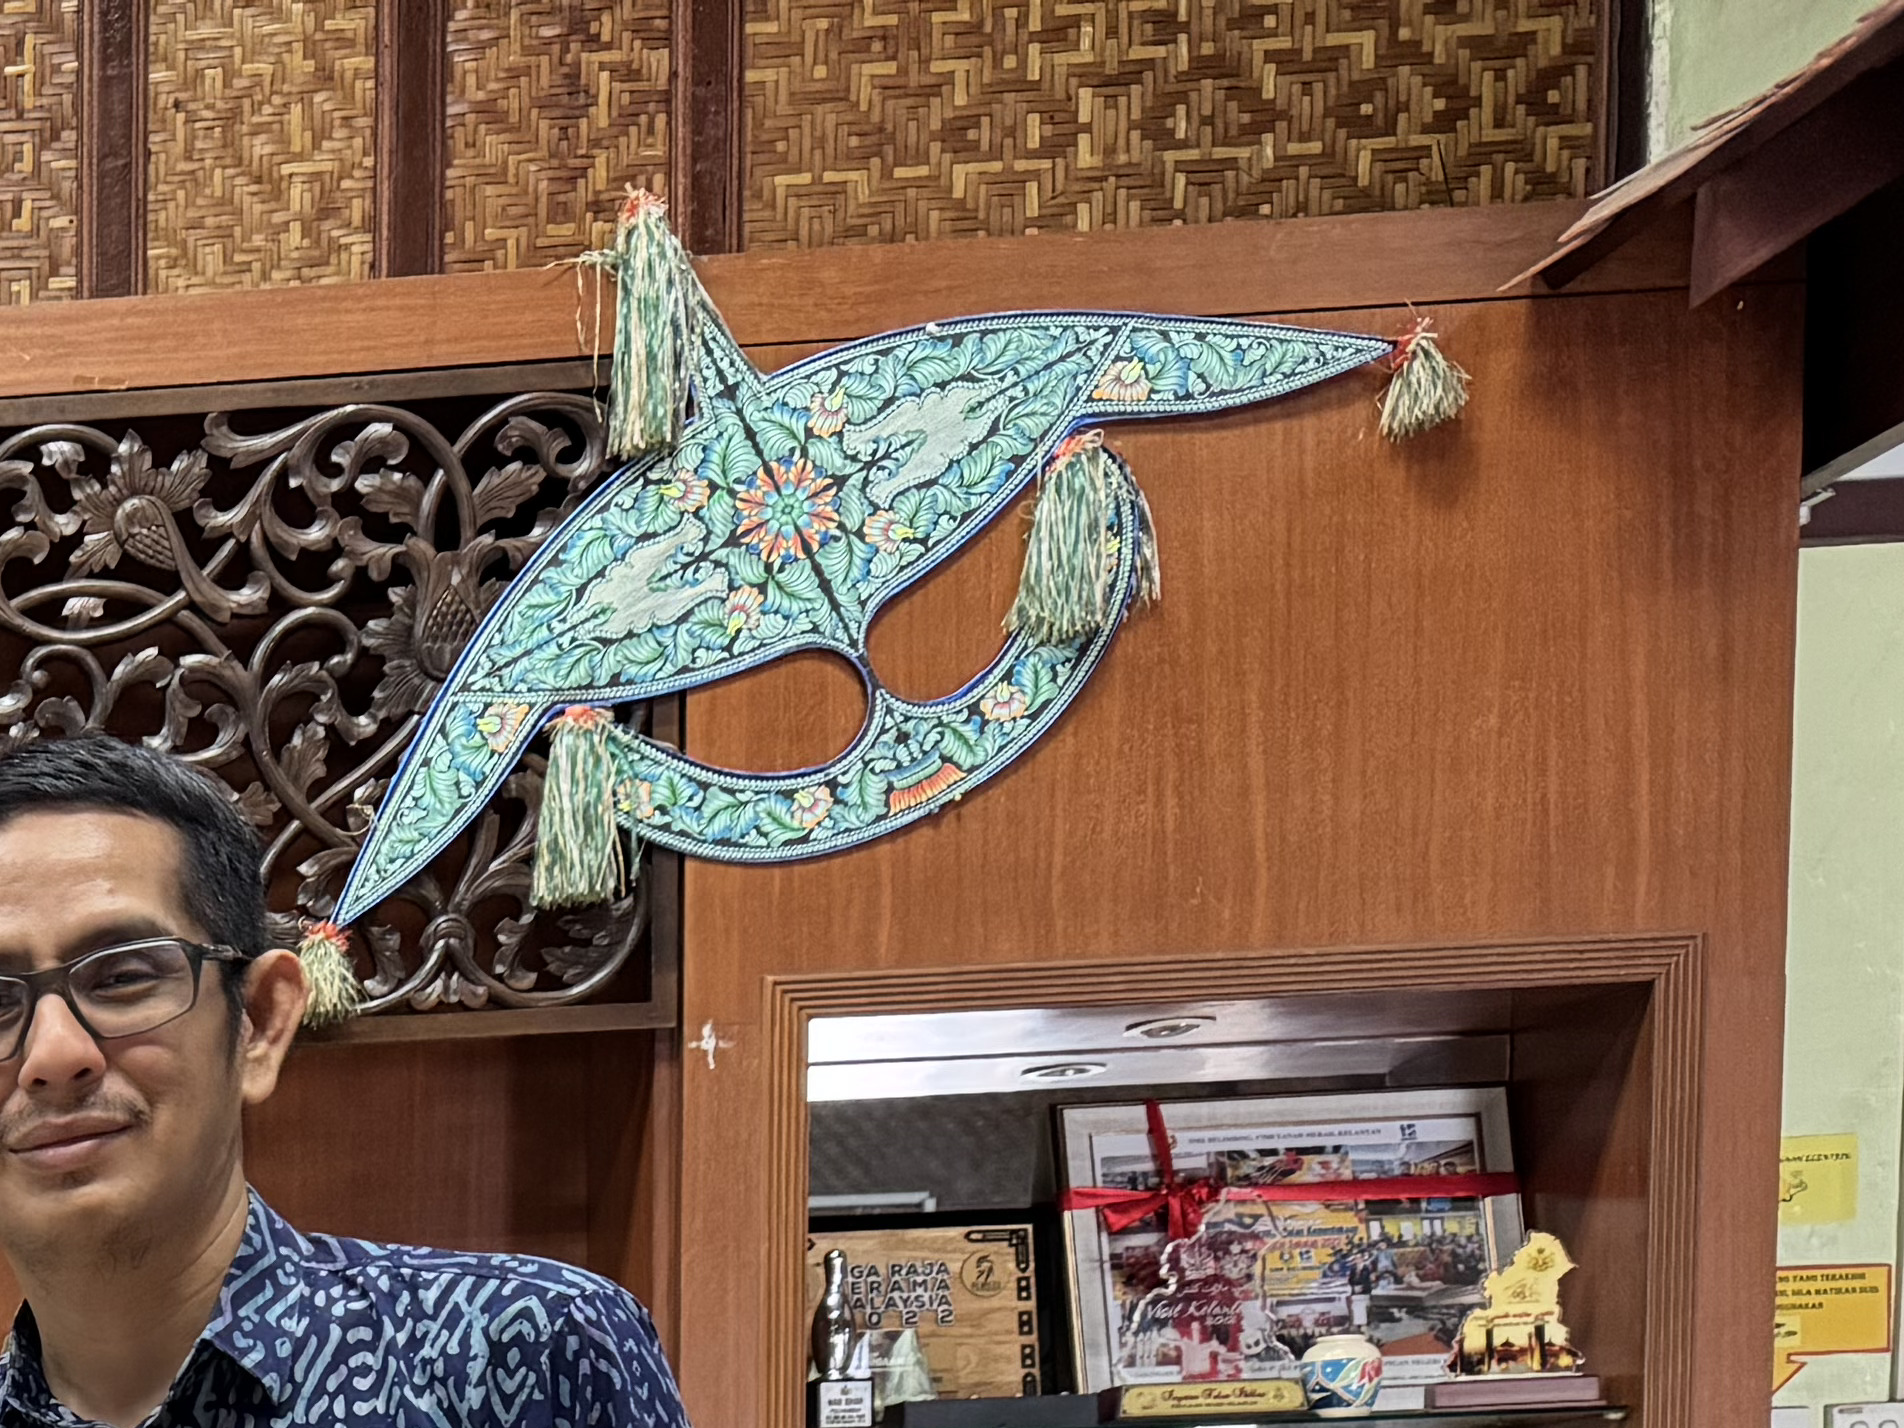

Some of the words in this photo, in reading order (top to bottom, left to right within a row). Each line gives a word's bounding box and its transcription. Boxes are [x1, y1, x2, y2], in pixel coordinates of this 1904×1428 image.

[849, 1263, 882, 1280] GA
[890, 1261, 951, 1278] RAJA
[849, 1277, 951, 1296] ERAMA
[851, 1293, 953, 1311] ALAYSIA
[866, 1308, 956, 1328] 022
